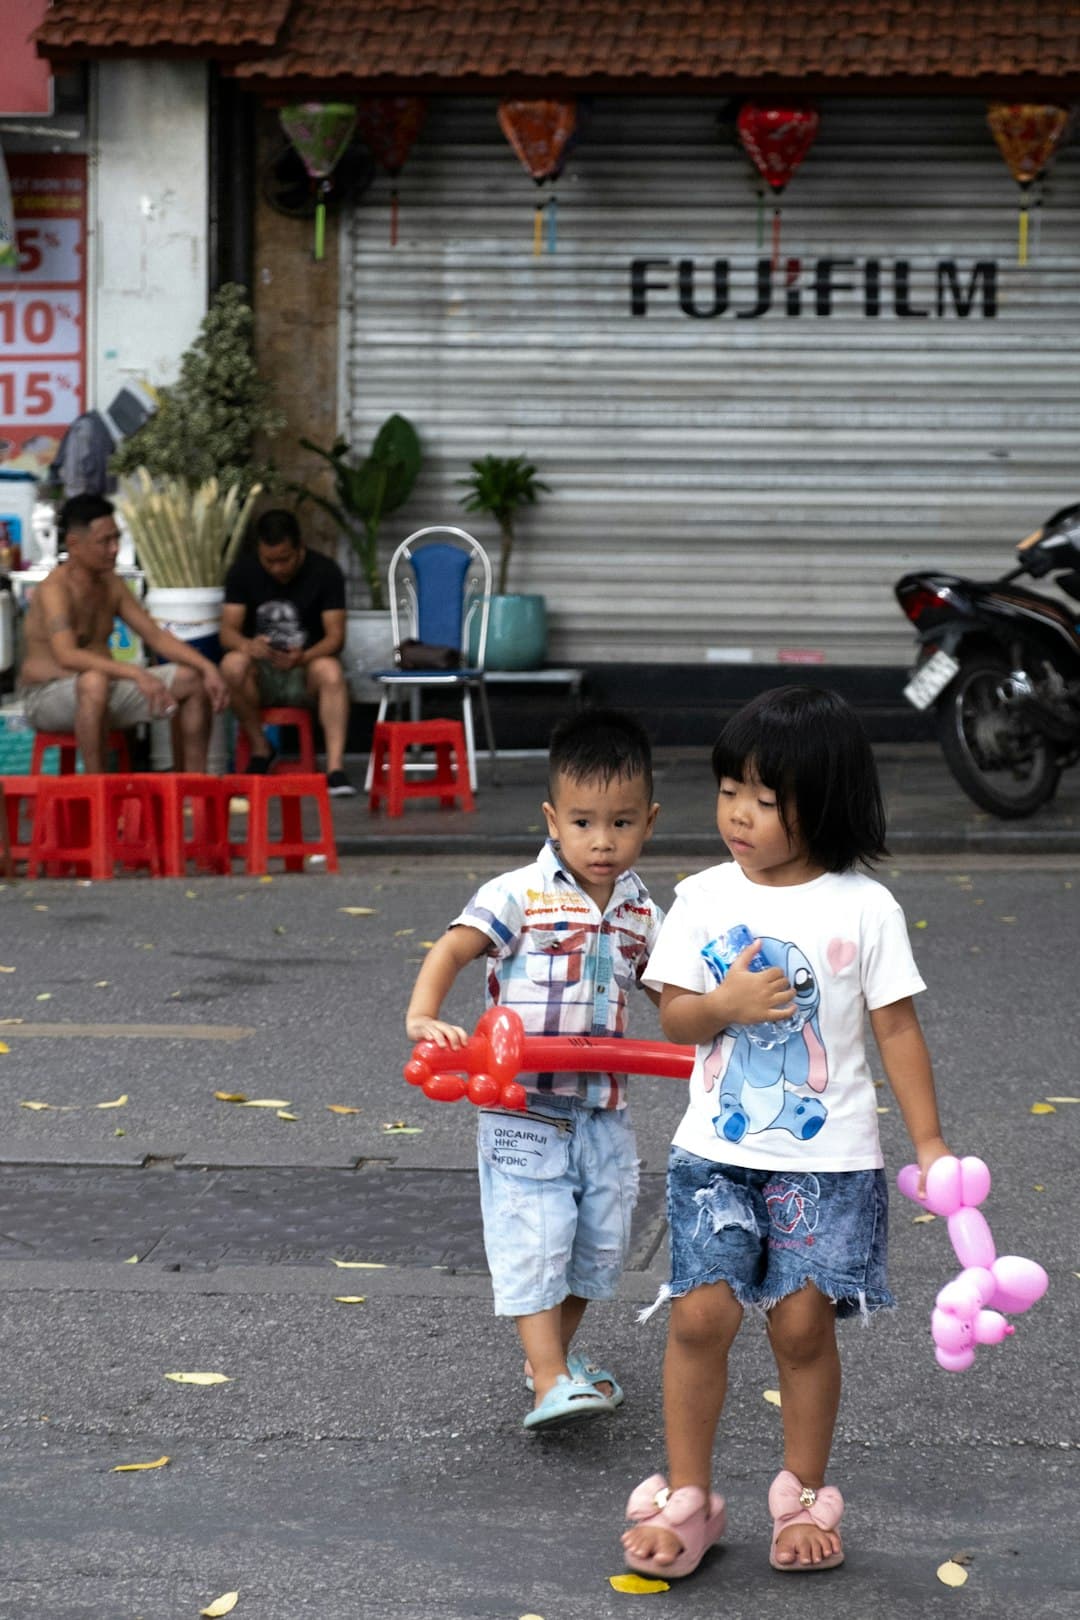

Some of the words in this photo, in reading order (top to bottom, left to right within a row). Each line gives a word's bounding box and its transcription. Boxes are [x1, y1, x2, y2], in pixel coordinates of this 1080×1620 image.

[630, 259, 999, 319] FUJIFILM
[0, 299, 71, 345] 10%
[0, 372, 71, 416] 15%
[495, 1139, 518, 1147] HHC
